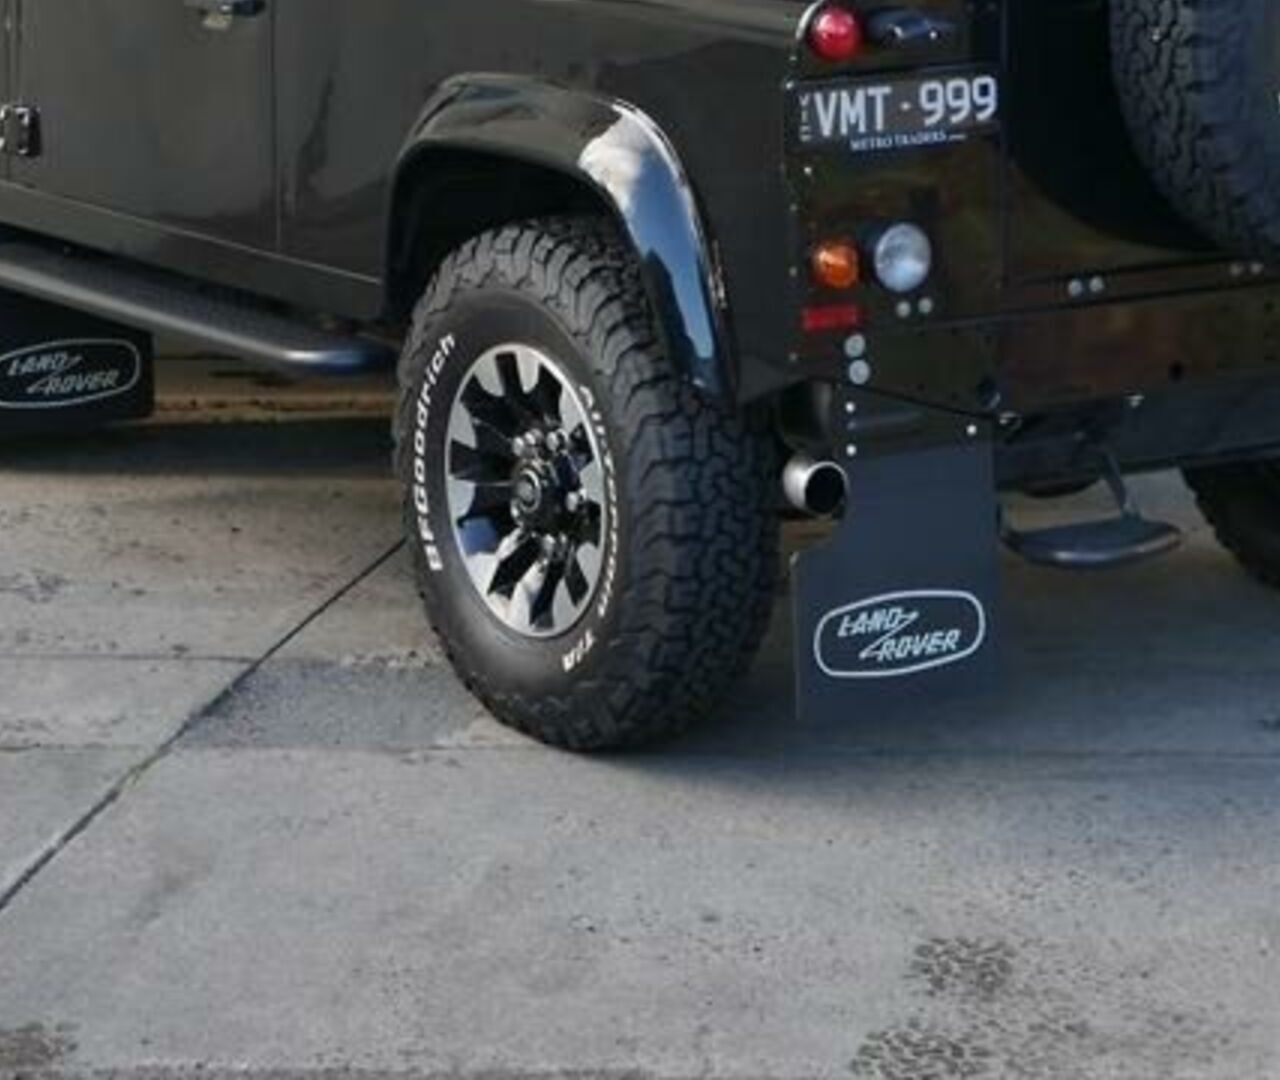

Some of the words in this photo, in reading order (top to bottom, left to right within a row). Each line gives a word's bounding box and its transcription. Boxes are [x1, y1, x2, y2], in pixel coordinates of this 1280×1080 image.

[7, 352, 68, 376] LAND
[44, 370, 120, 396] ROVER
[836, 606, 904, 638] LAND
[876, 629, 962, 662] ROVER
